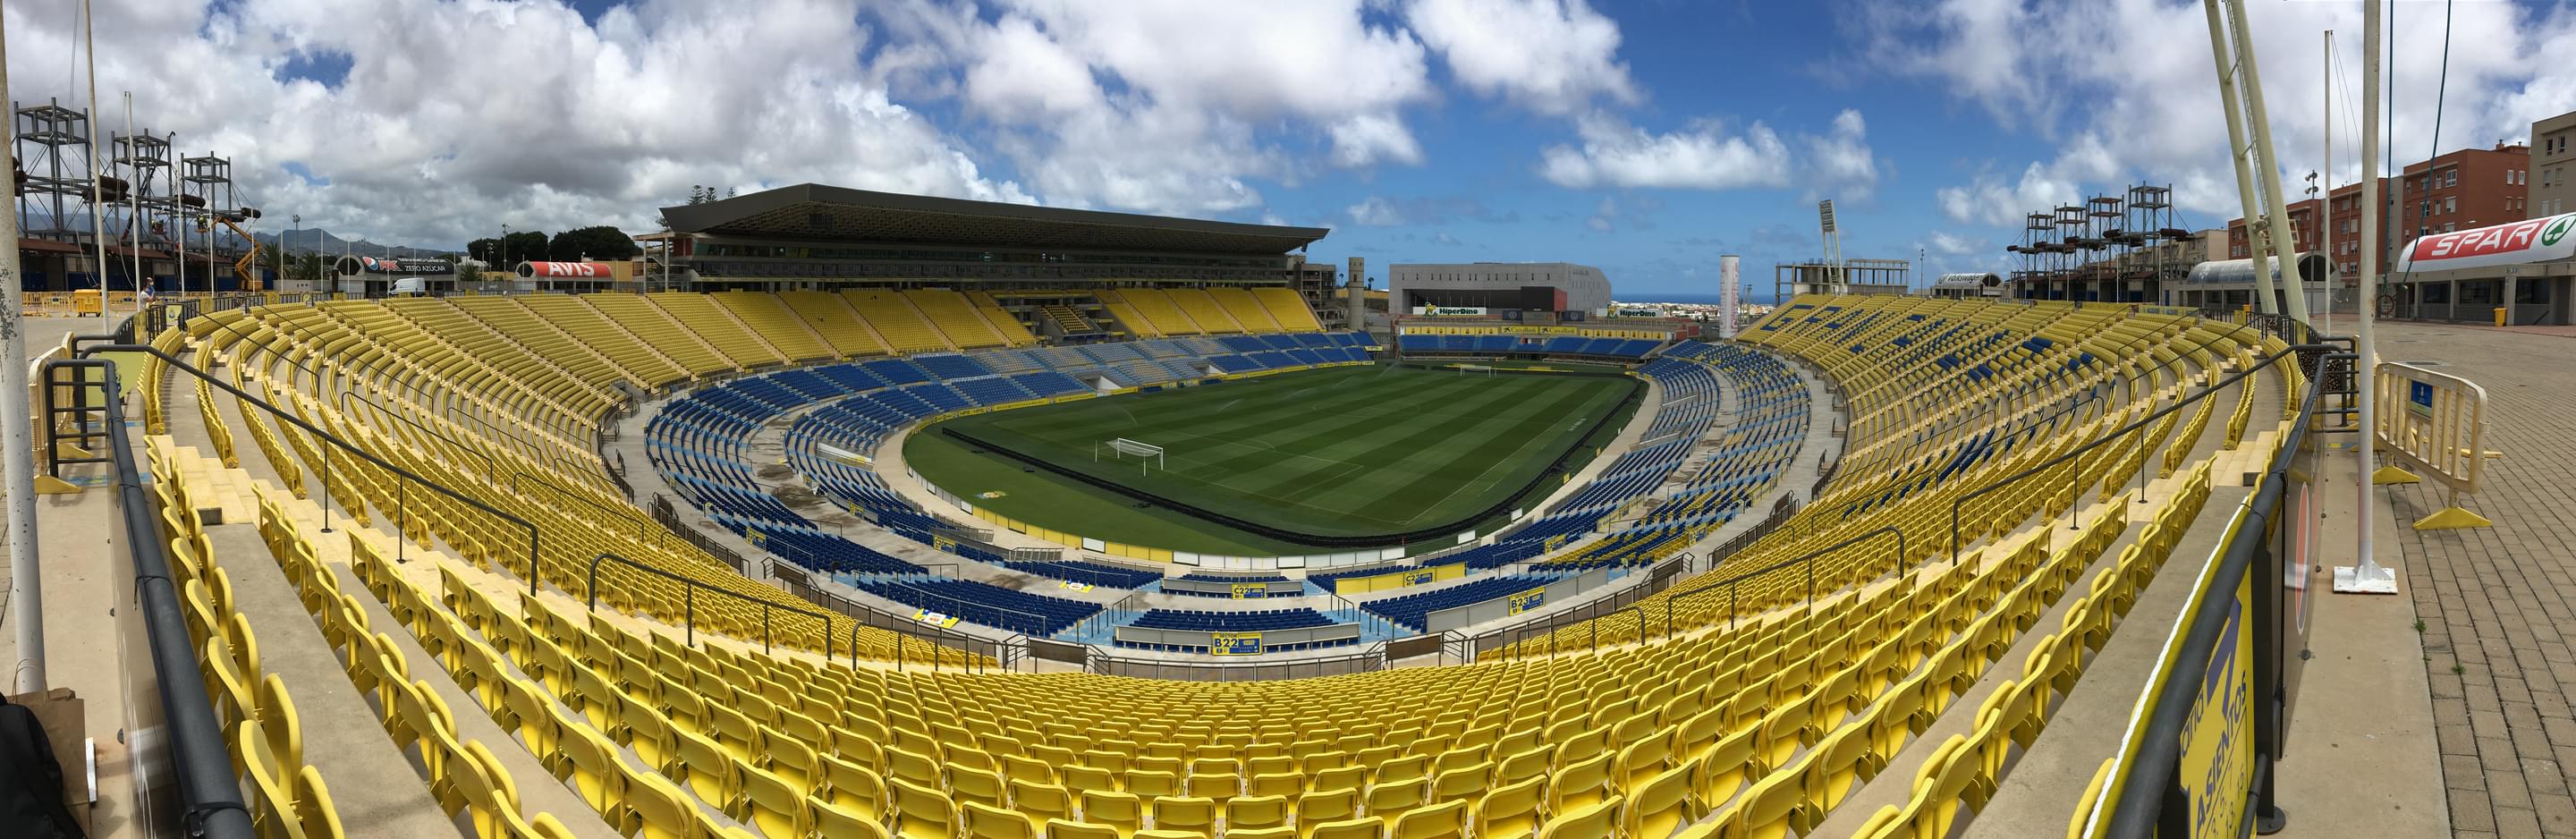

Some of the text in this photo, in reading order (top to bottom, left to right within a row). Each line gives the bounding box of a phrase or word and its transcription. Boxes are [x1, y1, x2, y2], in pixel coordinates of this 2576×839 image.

[2432, 223, 2539, 257] SPAR
[422, 264, 445, 272] AZÚCAR
[547, 261, 594, 275] AVIS
[1620, 309, 1657, 318] HiperDino
[1512, 597, 1529, 607] B23
[1215, 638, 1238, 648] B22
[2196, 670, 2247, 836] ASIENTOS
